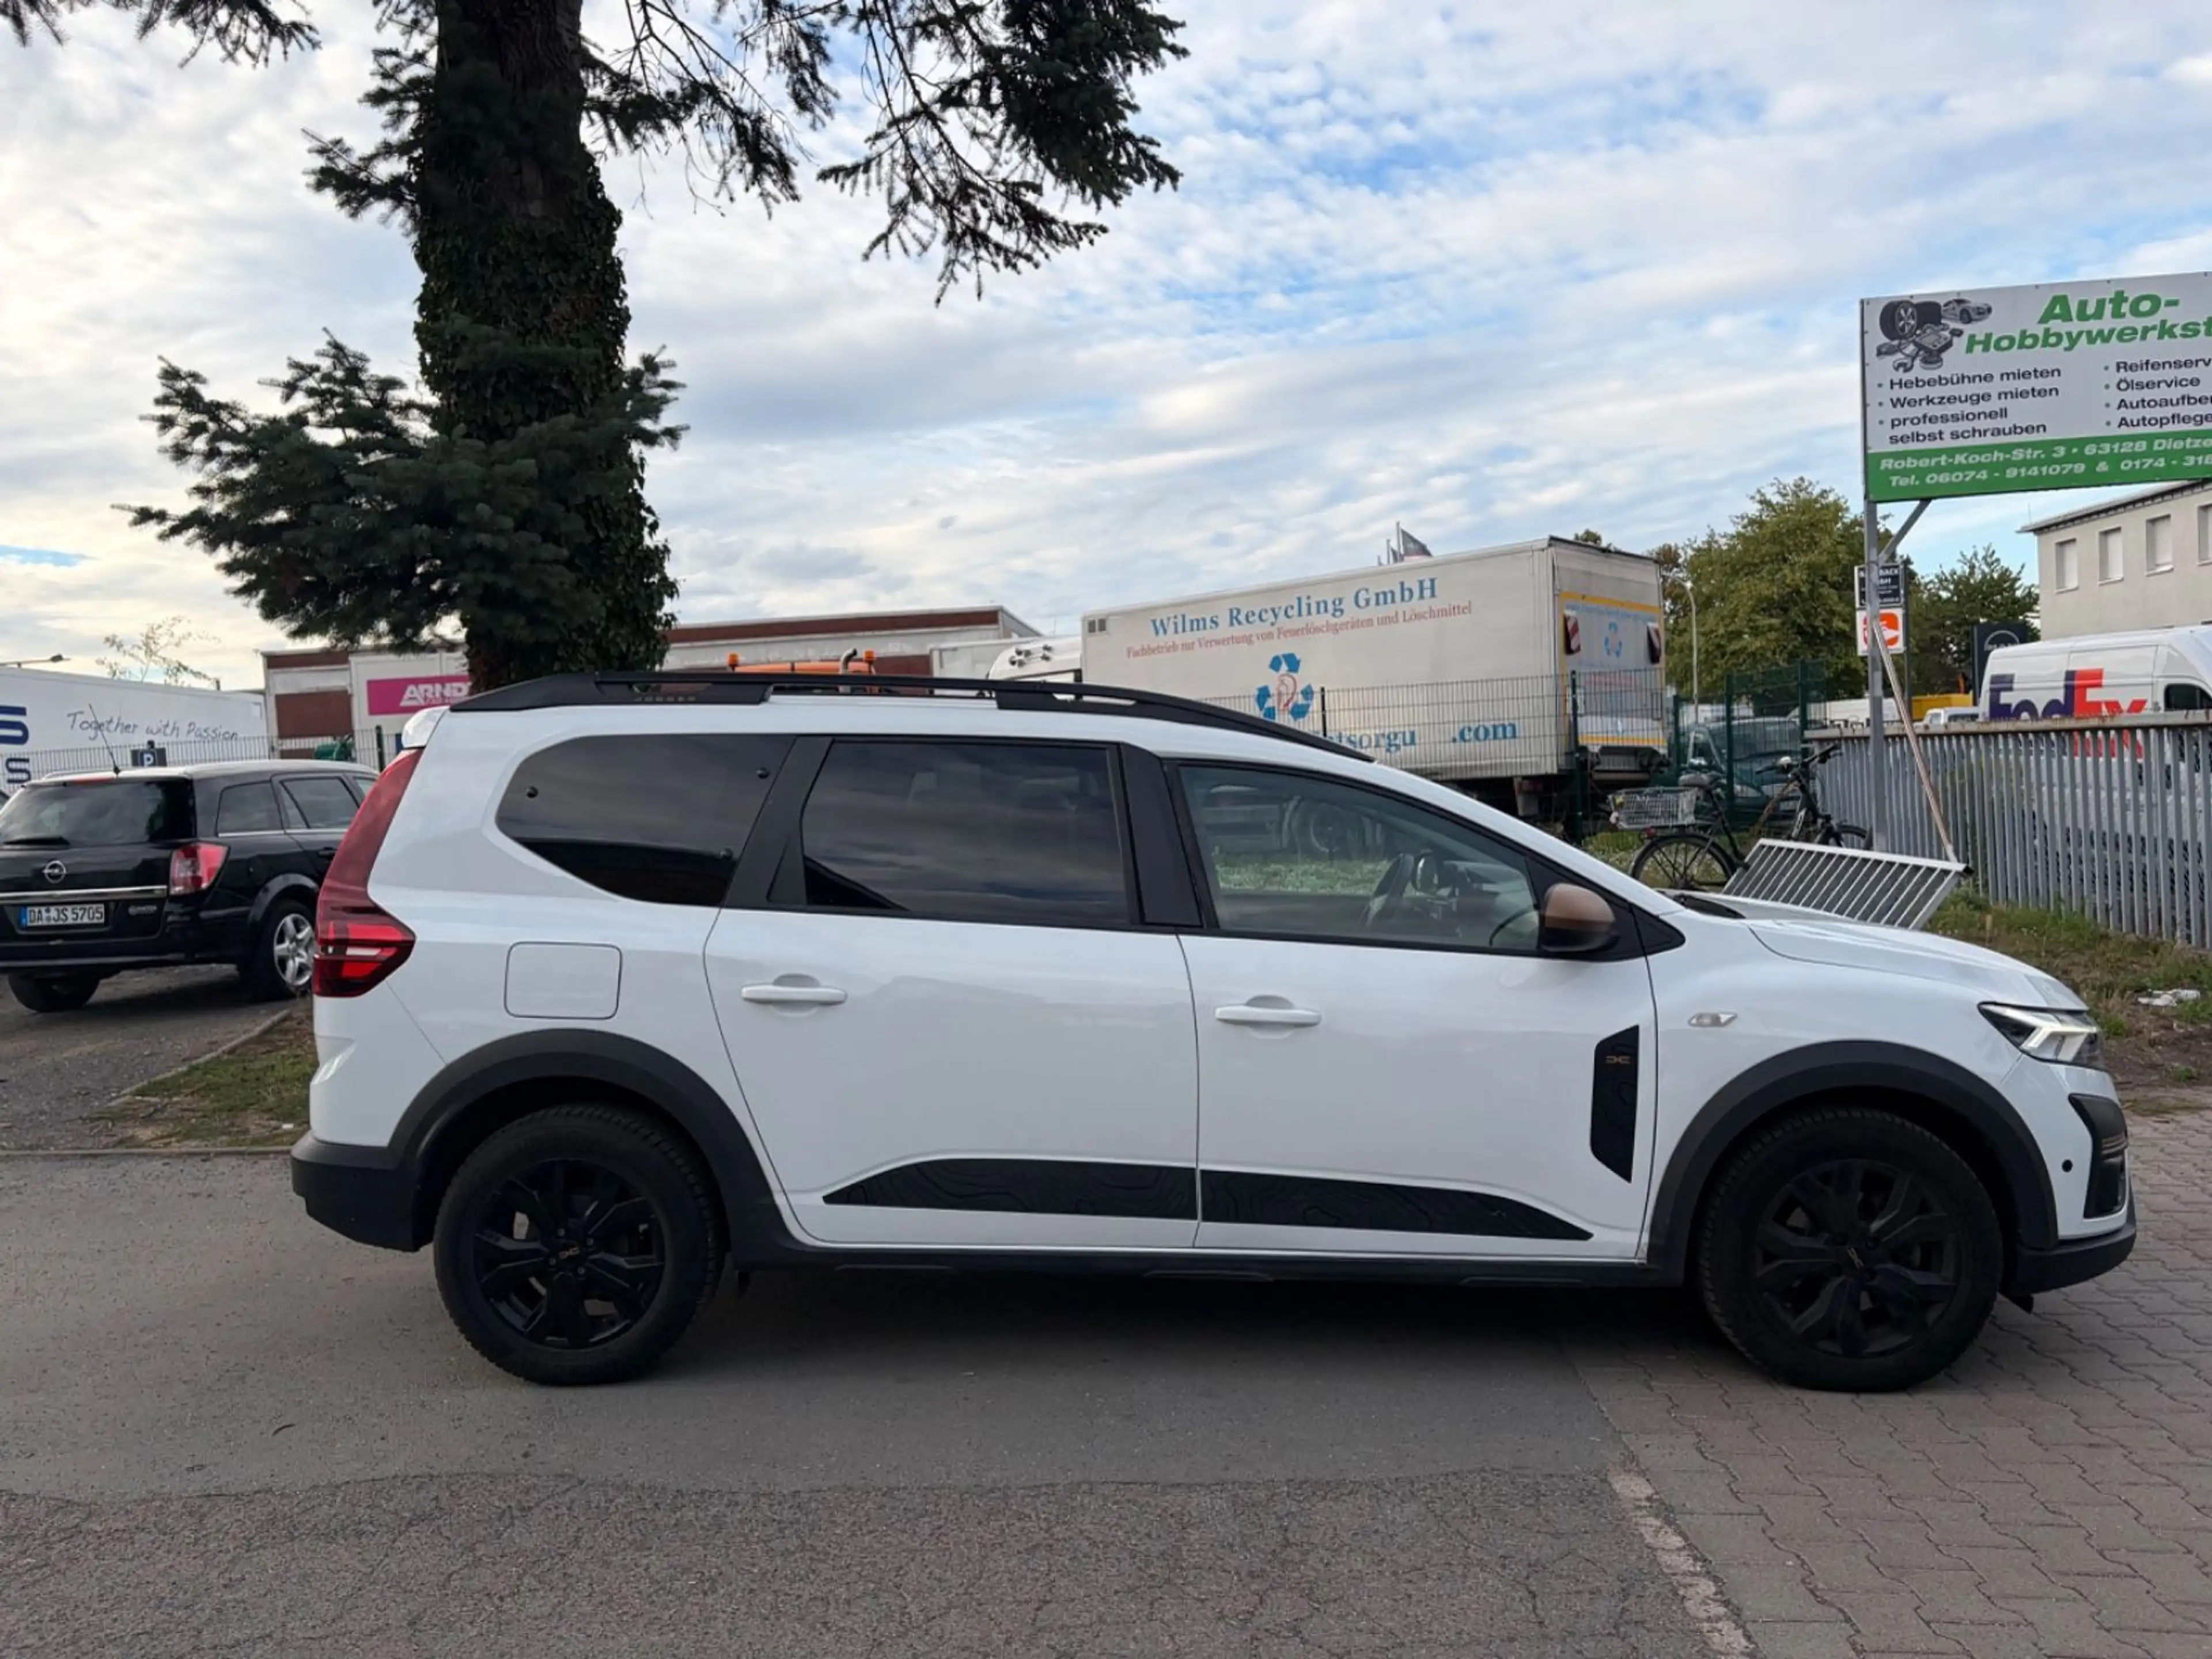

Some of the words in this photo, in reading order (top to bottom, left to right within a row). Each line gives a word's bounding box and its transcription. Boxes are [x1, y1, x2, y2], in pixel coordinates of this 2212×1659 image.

[2037, 290, 2180, 324] Auto-
[1965, 316, 2212, 354] Hobbywerkst
[2116, 357, 2212, 373] Reifenserv
[1889, 372, 1994, 391] Hebebühne
[1999, 368, 2061, 381] mieten
[2116, 376, 2201, 392] Ölservice
[1889, 392, 1992, 409] Werkzeuge
[1998, 386, 2059, 401] mieten
[1890, 406, 2008, 429] professionell
[2118, 412, 2212, 429] Autopflege
[1889, 429, 1945, 445] selbst
[1949, 423, 2047, 440] schrauben
[1880, 448, 2046, 471] Robert-Koch-Str.
[2051, 445, 2066, 458] 3
[2084, 440, 2147, 456] 63128
[1889, 475, 1920, 487] Tel.
[1925, 469, 1988, 484] 06074
[2096, 461, 2109, 473] &
[2120, 457, 2166, 471] 0174
[1150, 613, 1220, 638] Wilms
[1228, 594, 1346, 627] Recycling
[1353, 577, 1438, 610] GmbH
[1126, 641, 1178, 660] Fachbetrieb
[1197, 631, 1254, 649] Verwertung
[1256, 631, 1274, 641] von
[1277, 616, 1374, 640] Feuerlöschgeräten
[1376, 611, 1399, 627] und
[1403, 600, 1472, 623] Löschmittel
[400, 681, 472, 707] ARND
[66, 710, 138, 741] Together
[145, 718, 180, 738] with
[186, 721, 238, 741] Passion
[1312, 729, 1417, 752] tsorgu
[1451, 721, 1518, 744] .com
[142, 753, 154, 767] P
[52, 908, 68, 923] JS
[71, 906, 104, 922] 5705
